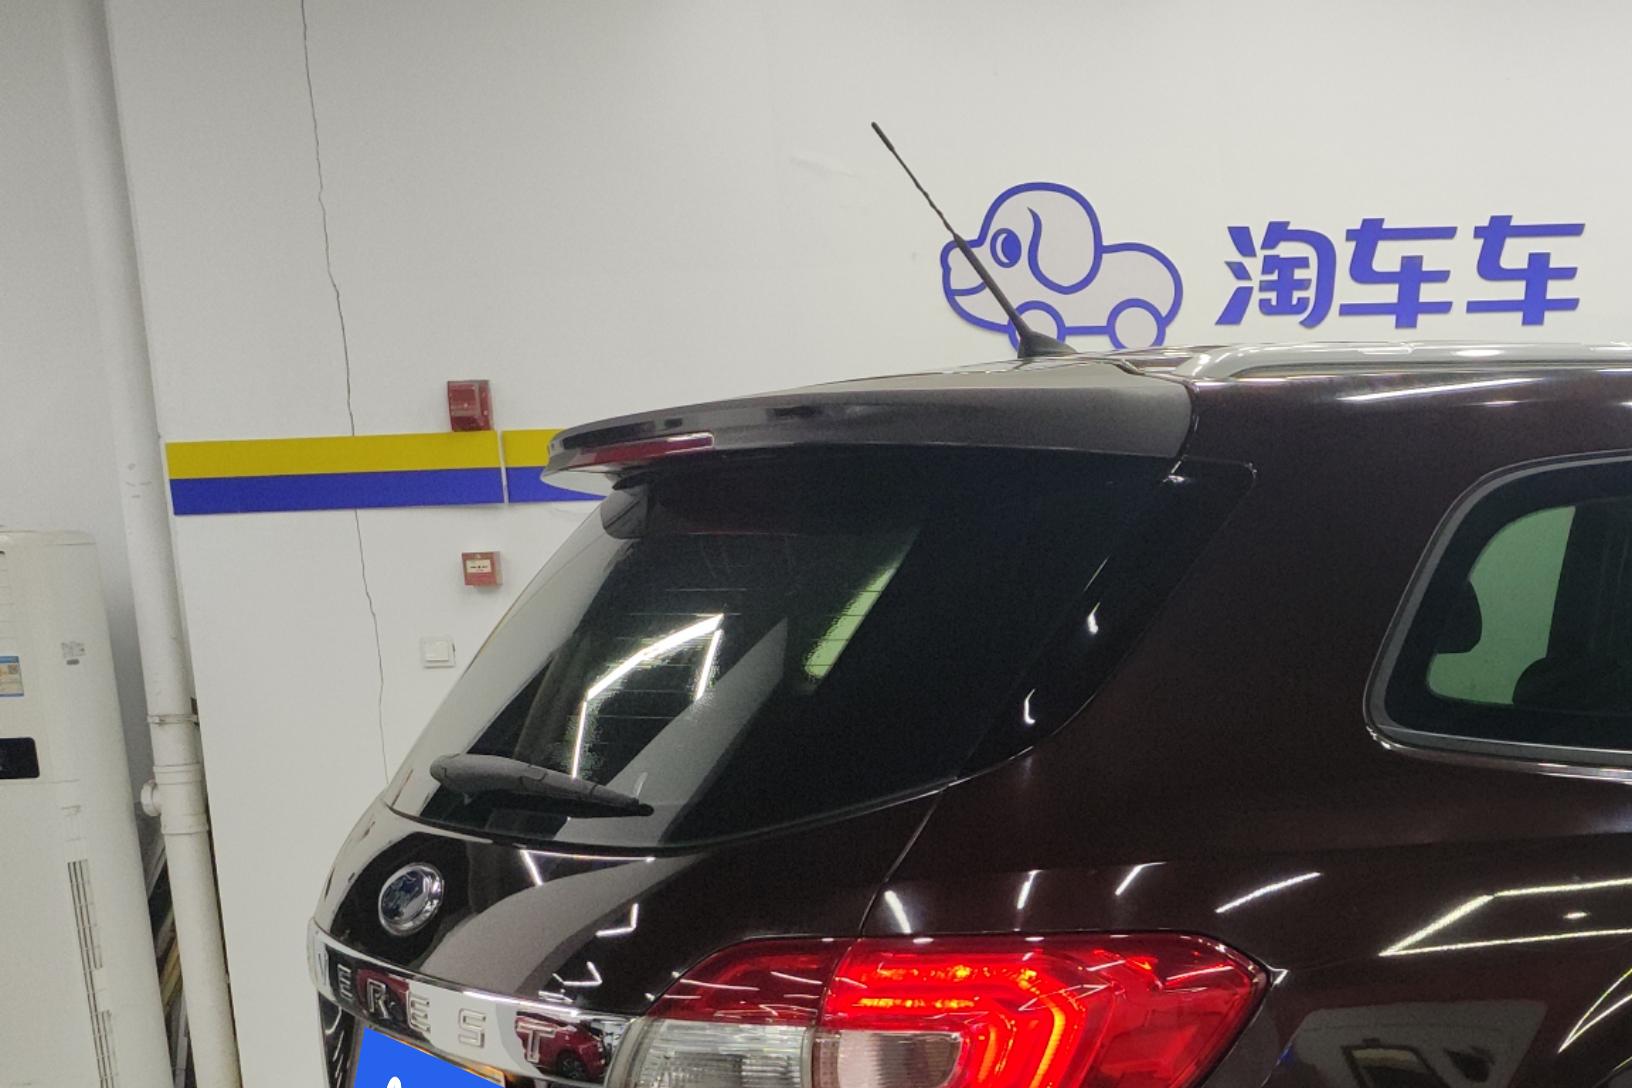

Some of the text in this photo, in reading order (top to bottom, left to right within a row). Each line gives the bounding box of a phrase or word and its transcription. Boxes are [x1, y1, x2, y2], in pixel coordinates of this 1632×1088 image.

[1215, 215, 1586, 329] 淘车车
[315, 948, 558, 1064] VEREST
